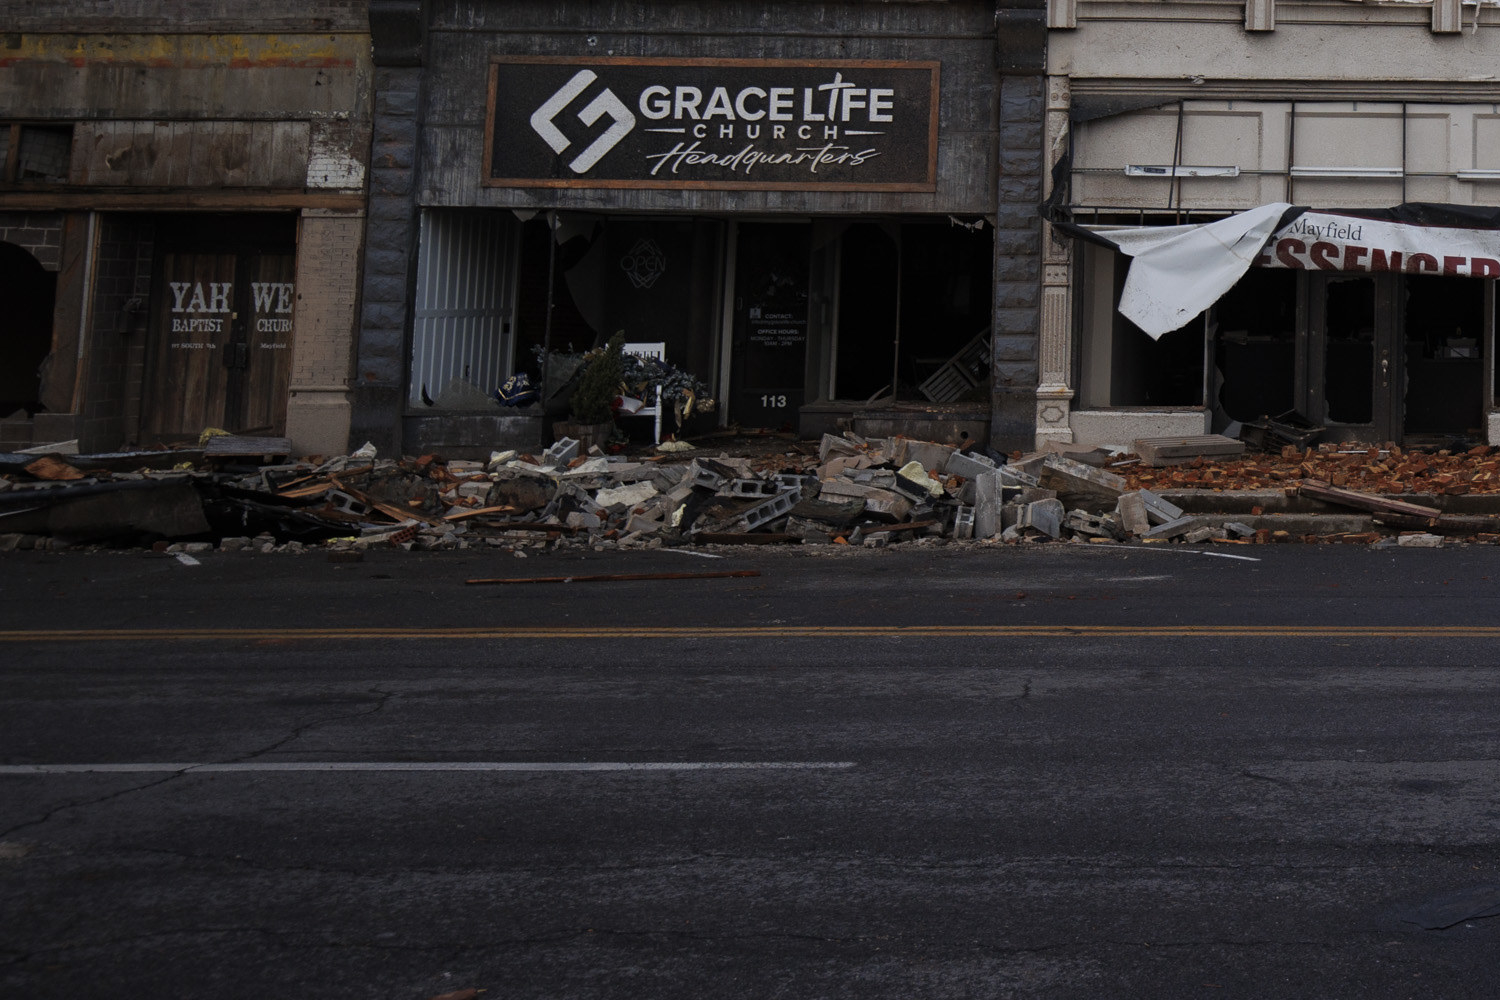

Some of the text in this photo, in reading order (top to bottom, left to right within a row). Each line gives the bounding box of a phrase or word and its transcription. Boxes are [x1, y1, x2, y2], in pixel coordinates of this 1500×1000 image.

[638, 71, 895, 123] GRACE LIFE
[692, 123, 838, 141] CHURCH
[645, 140, 882, 176] Headquarters
[1288, 218, 1362, 241] Mayfield
[619, 255, 666, 273] OPEN
[169, 282, 294, 314] YAH WE
[172, 318, 224, 332] BAPTIST
[760, 394, 787, 408] 113
